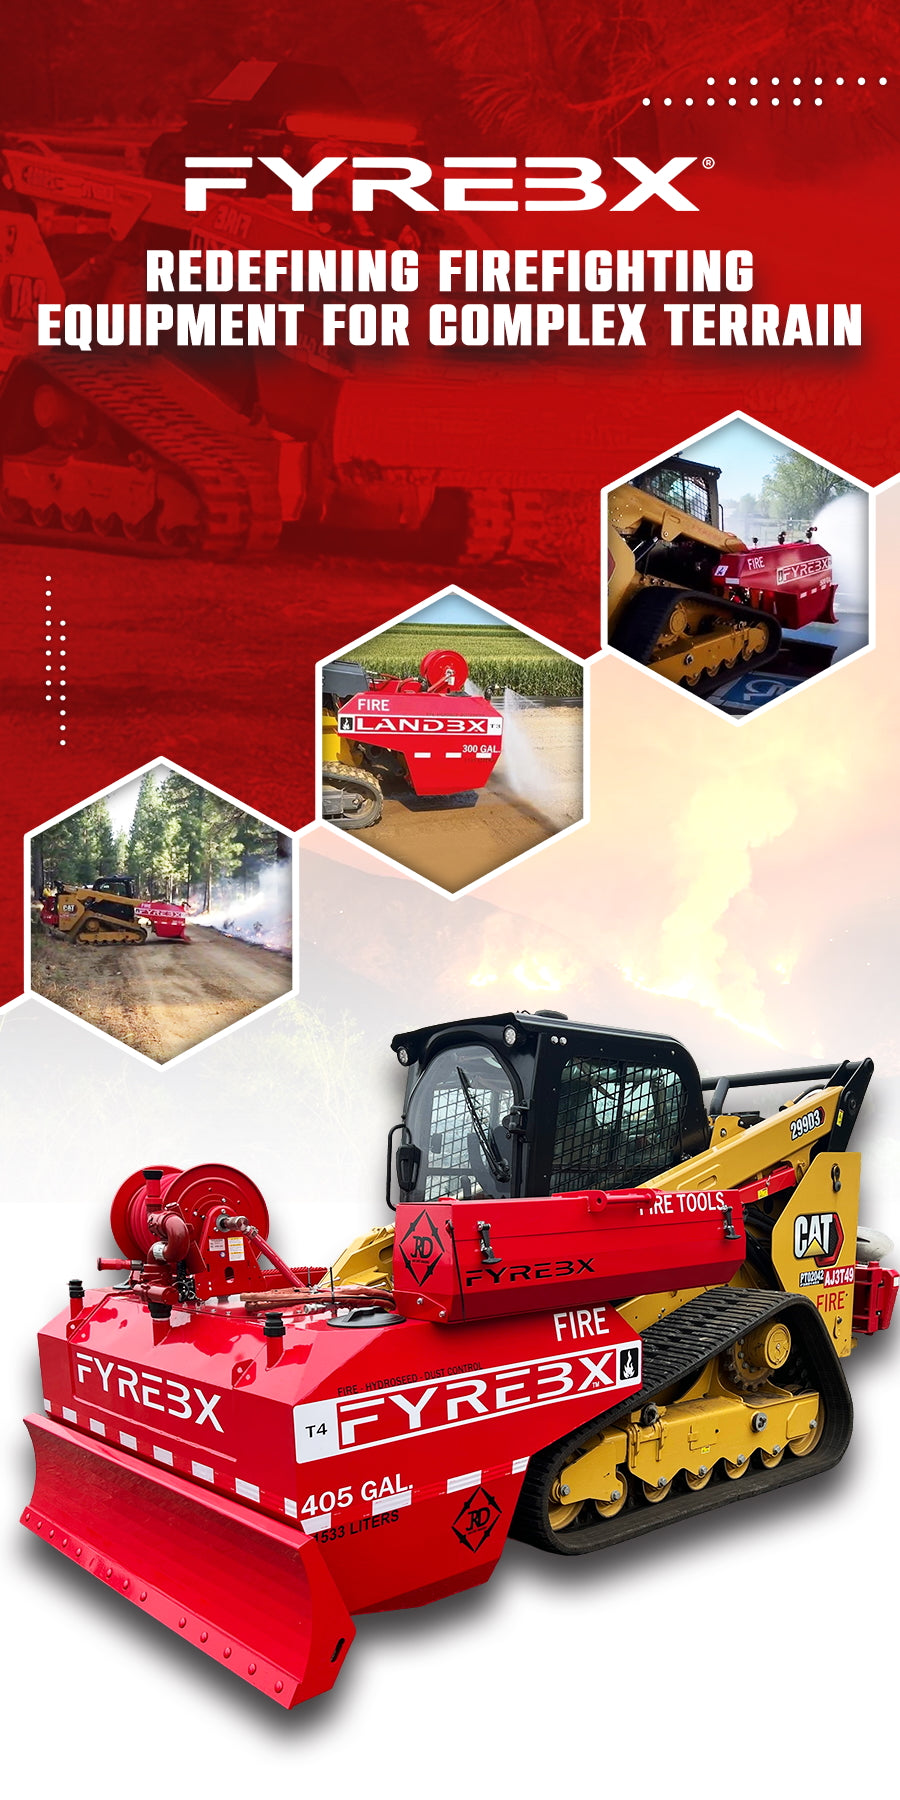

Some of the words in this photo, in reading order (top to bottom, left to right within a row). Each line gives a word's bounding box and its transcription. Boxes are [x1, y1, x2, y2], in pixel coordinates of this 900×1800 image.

[747, 556, 765, 570] FIRE
[357, 698, 390, 711] FIRE
[462, 744, 479, 753] 300
[62, 904, 75, 912] CAT
[790, 1109, 821, 1140] 299D3
[639, 1193, 674, 1216] RE
[676, 1191, 727, 1213] TOOLS
[794, 1213, 833, 1259] CAT
[824, 1266, 855, 1287] AJ3T49
[816, 1290, 846, 1313] FIRE
[553, 1306, 610, 1342] FIRE
[337, 1384, 358, 1397] FIRE
[365, 1373, 418, 1392] HYDROSEED
[424, 1367, 446, 1381] DUST
[447, 1361, 484, 1376] CONTROL
[305, 1422, 328, 1438] T4
[301, 1485, 353, 1516] 405
[360, 1473, 413, 1501] GAL.
[314, 1525, 346, 1543] 1533
[350, 1509, 399, 1535] LITERS
